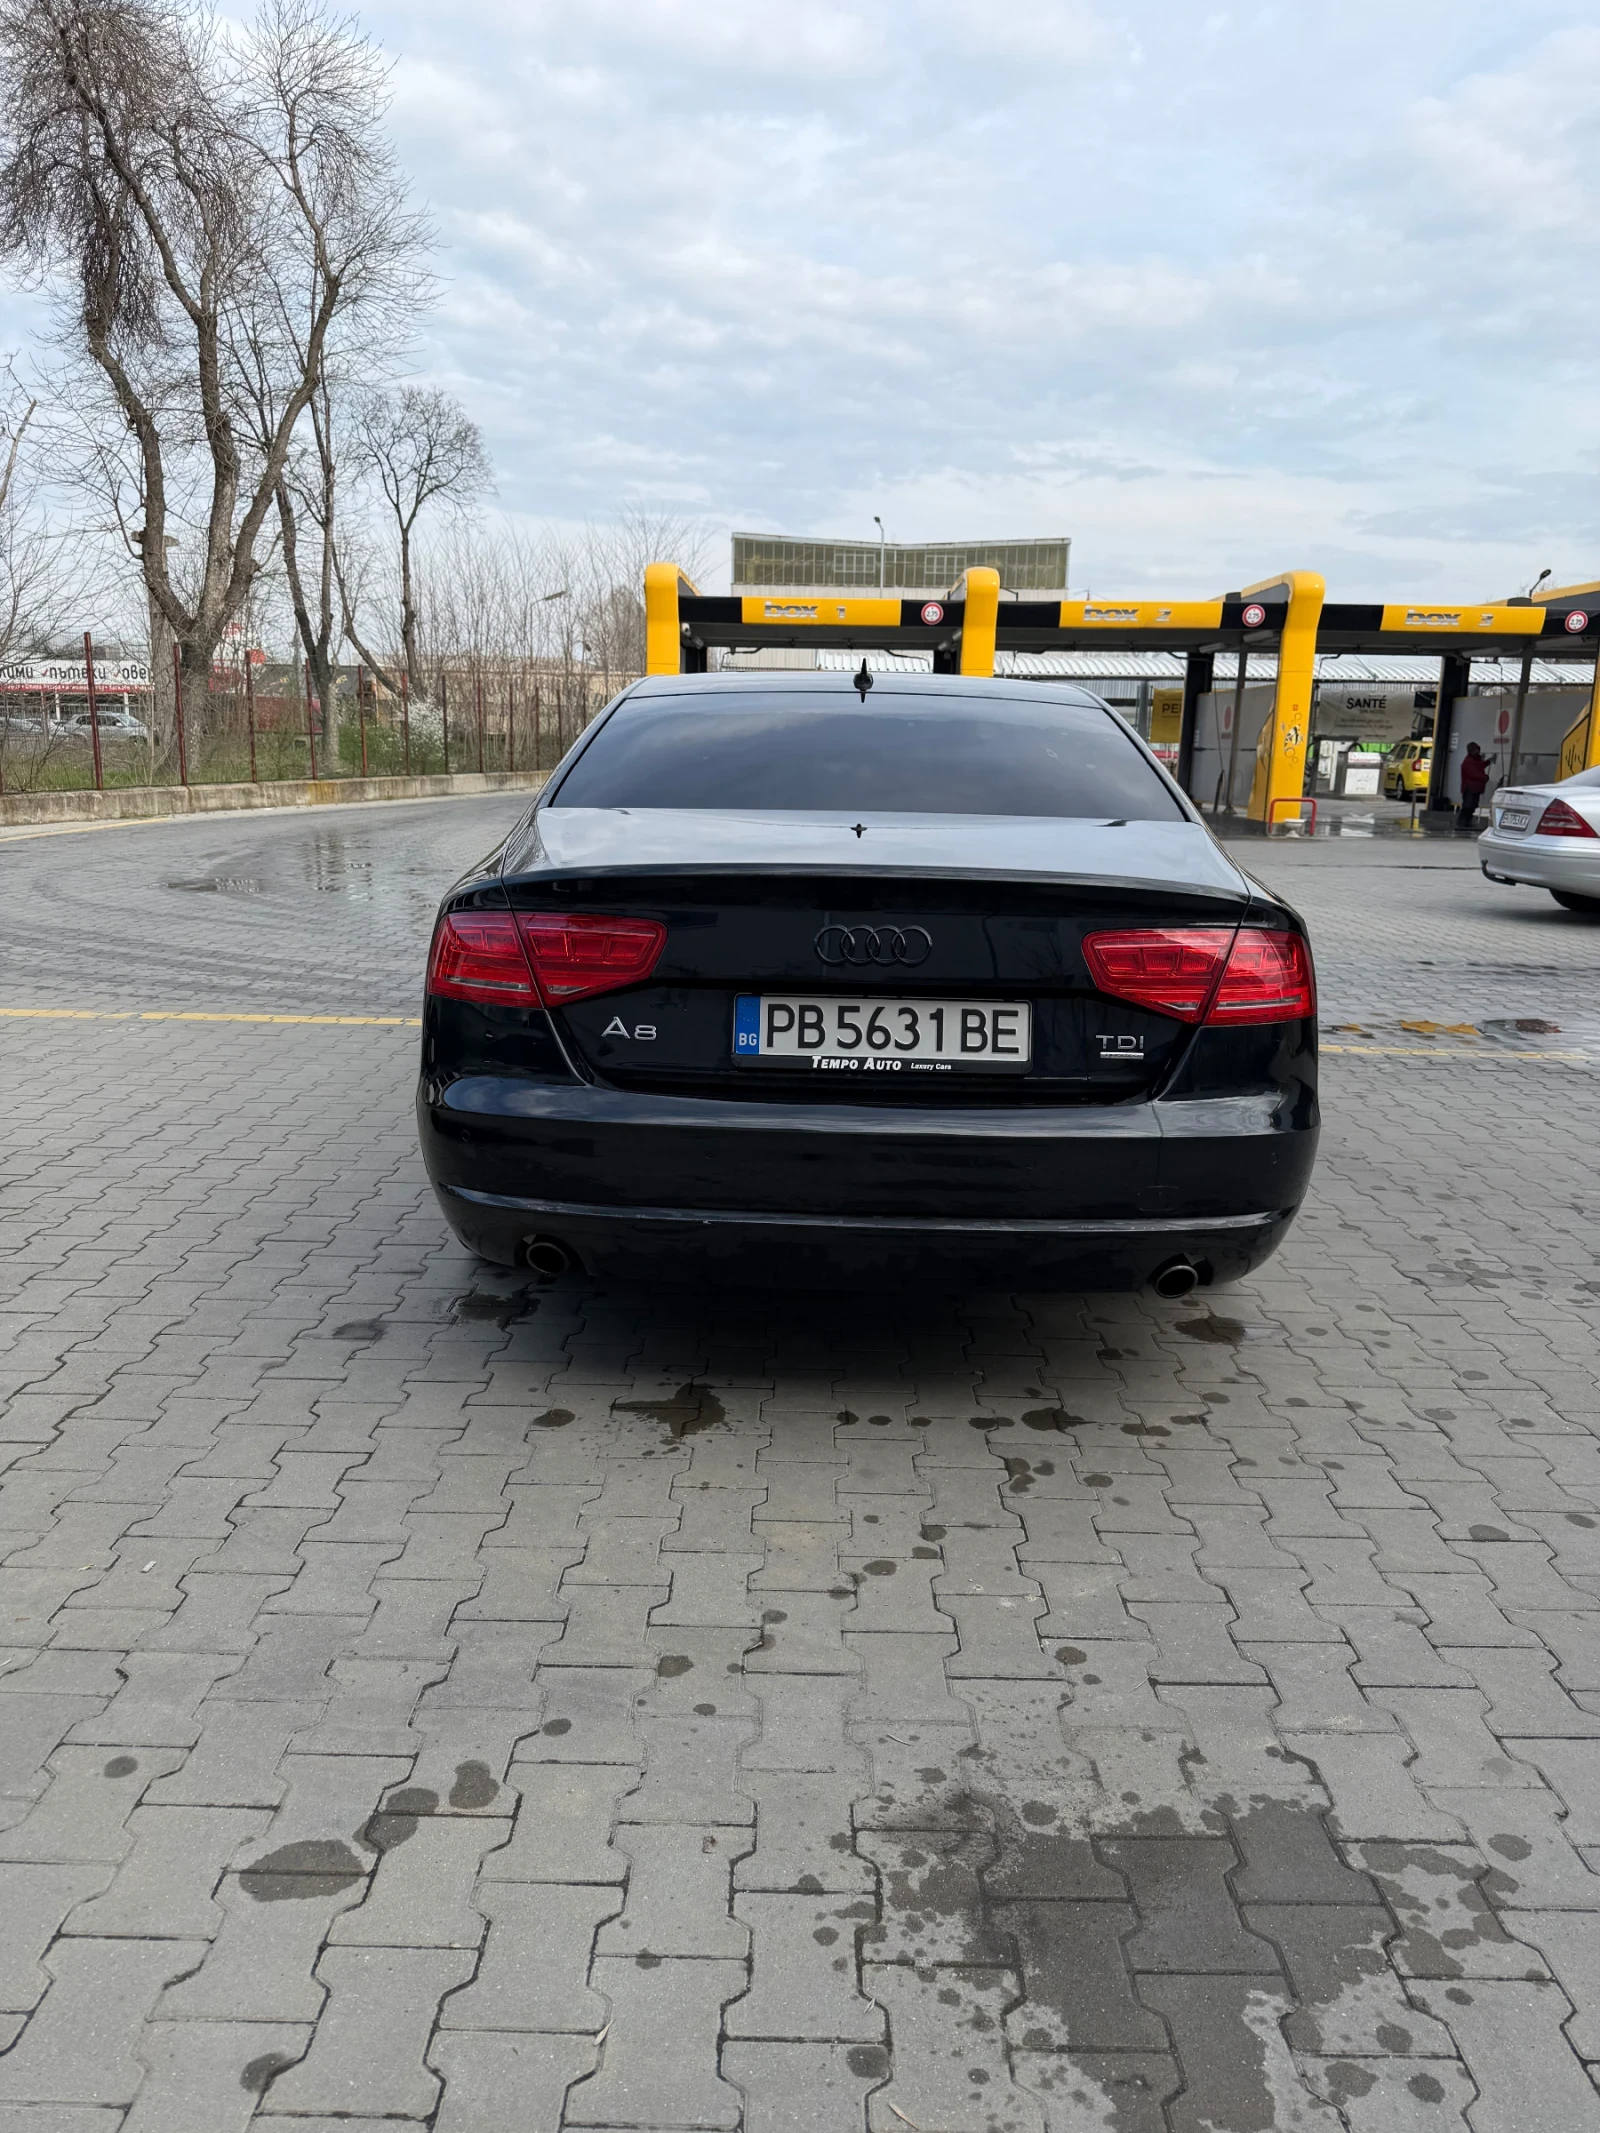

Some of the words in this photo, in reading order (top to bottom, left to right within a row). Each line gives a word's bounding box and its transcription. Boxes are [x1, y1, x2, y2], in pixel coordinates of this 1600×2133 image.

[764, 601, 818, 618] box
[836, 606, 846, 619] 1
[1083, 605, 1140, 621] box
[1156, 608, 1172, 622] 2
[1405, 609, 1462, 626] box
[1478, 613, 1494, 627] 3
[1162, 703, 1182, 714] PE
[1346, 695, 1387, 710] SANTÉ
[601, 1016, 657, 1040] A8
[739, 1033, 757, 1046] BG
[766, 1003, 826, 1049] PB
[836, 1006, 944, 1051] 5631
[960, 1008, 1020, 1053] BE
[1095, 1034, 1144, 1050] TDI
[910, 1062, 934, 1071] Luxury
